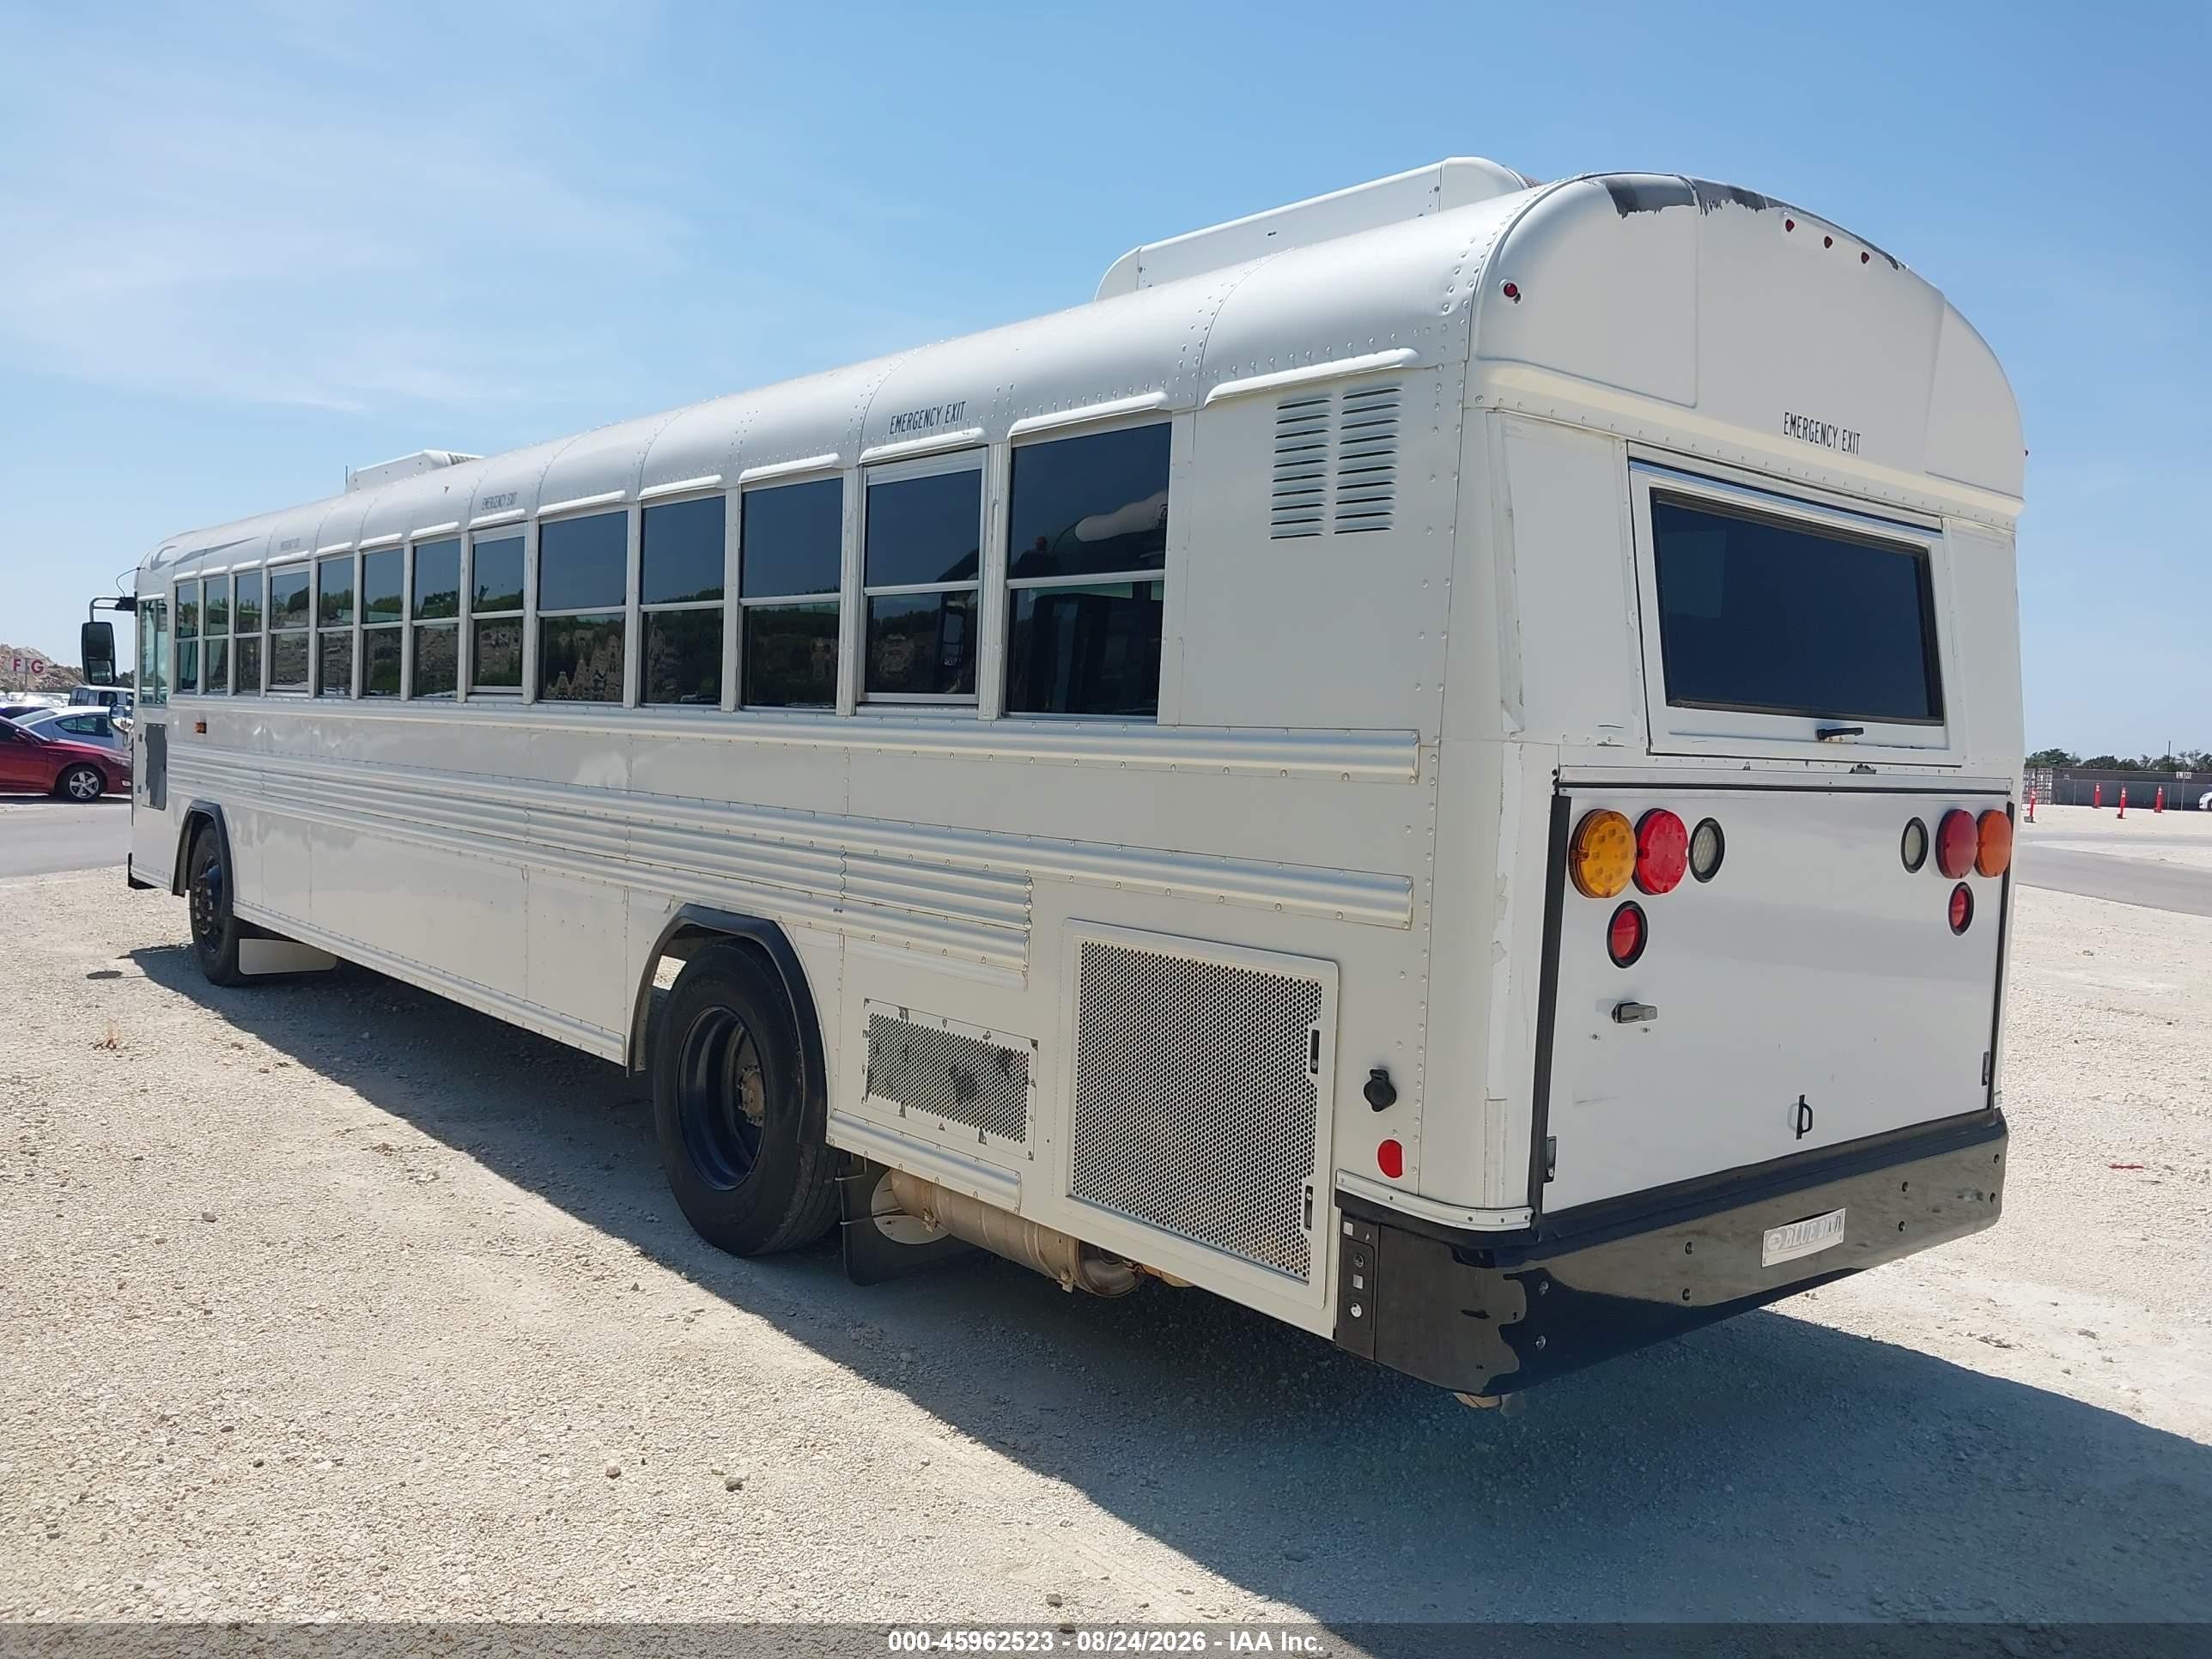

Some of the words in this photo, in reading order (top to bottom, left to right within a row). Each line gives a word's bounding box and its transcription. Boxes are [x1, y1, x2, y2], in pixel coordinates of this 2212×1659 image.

[890, 405, 943, 434] EMERGENCY
[945, 401, 966, 424] EXIT
[1784, 411, 1838, 449] EMERGENCY
[1842, 429, 1861, 455] EXIT
[13, 658, 21, 672] F
[31, 659, 45, 674] G
[1785, 1222, 1816, 1247] BLUE
